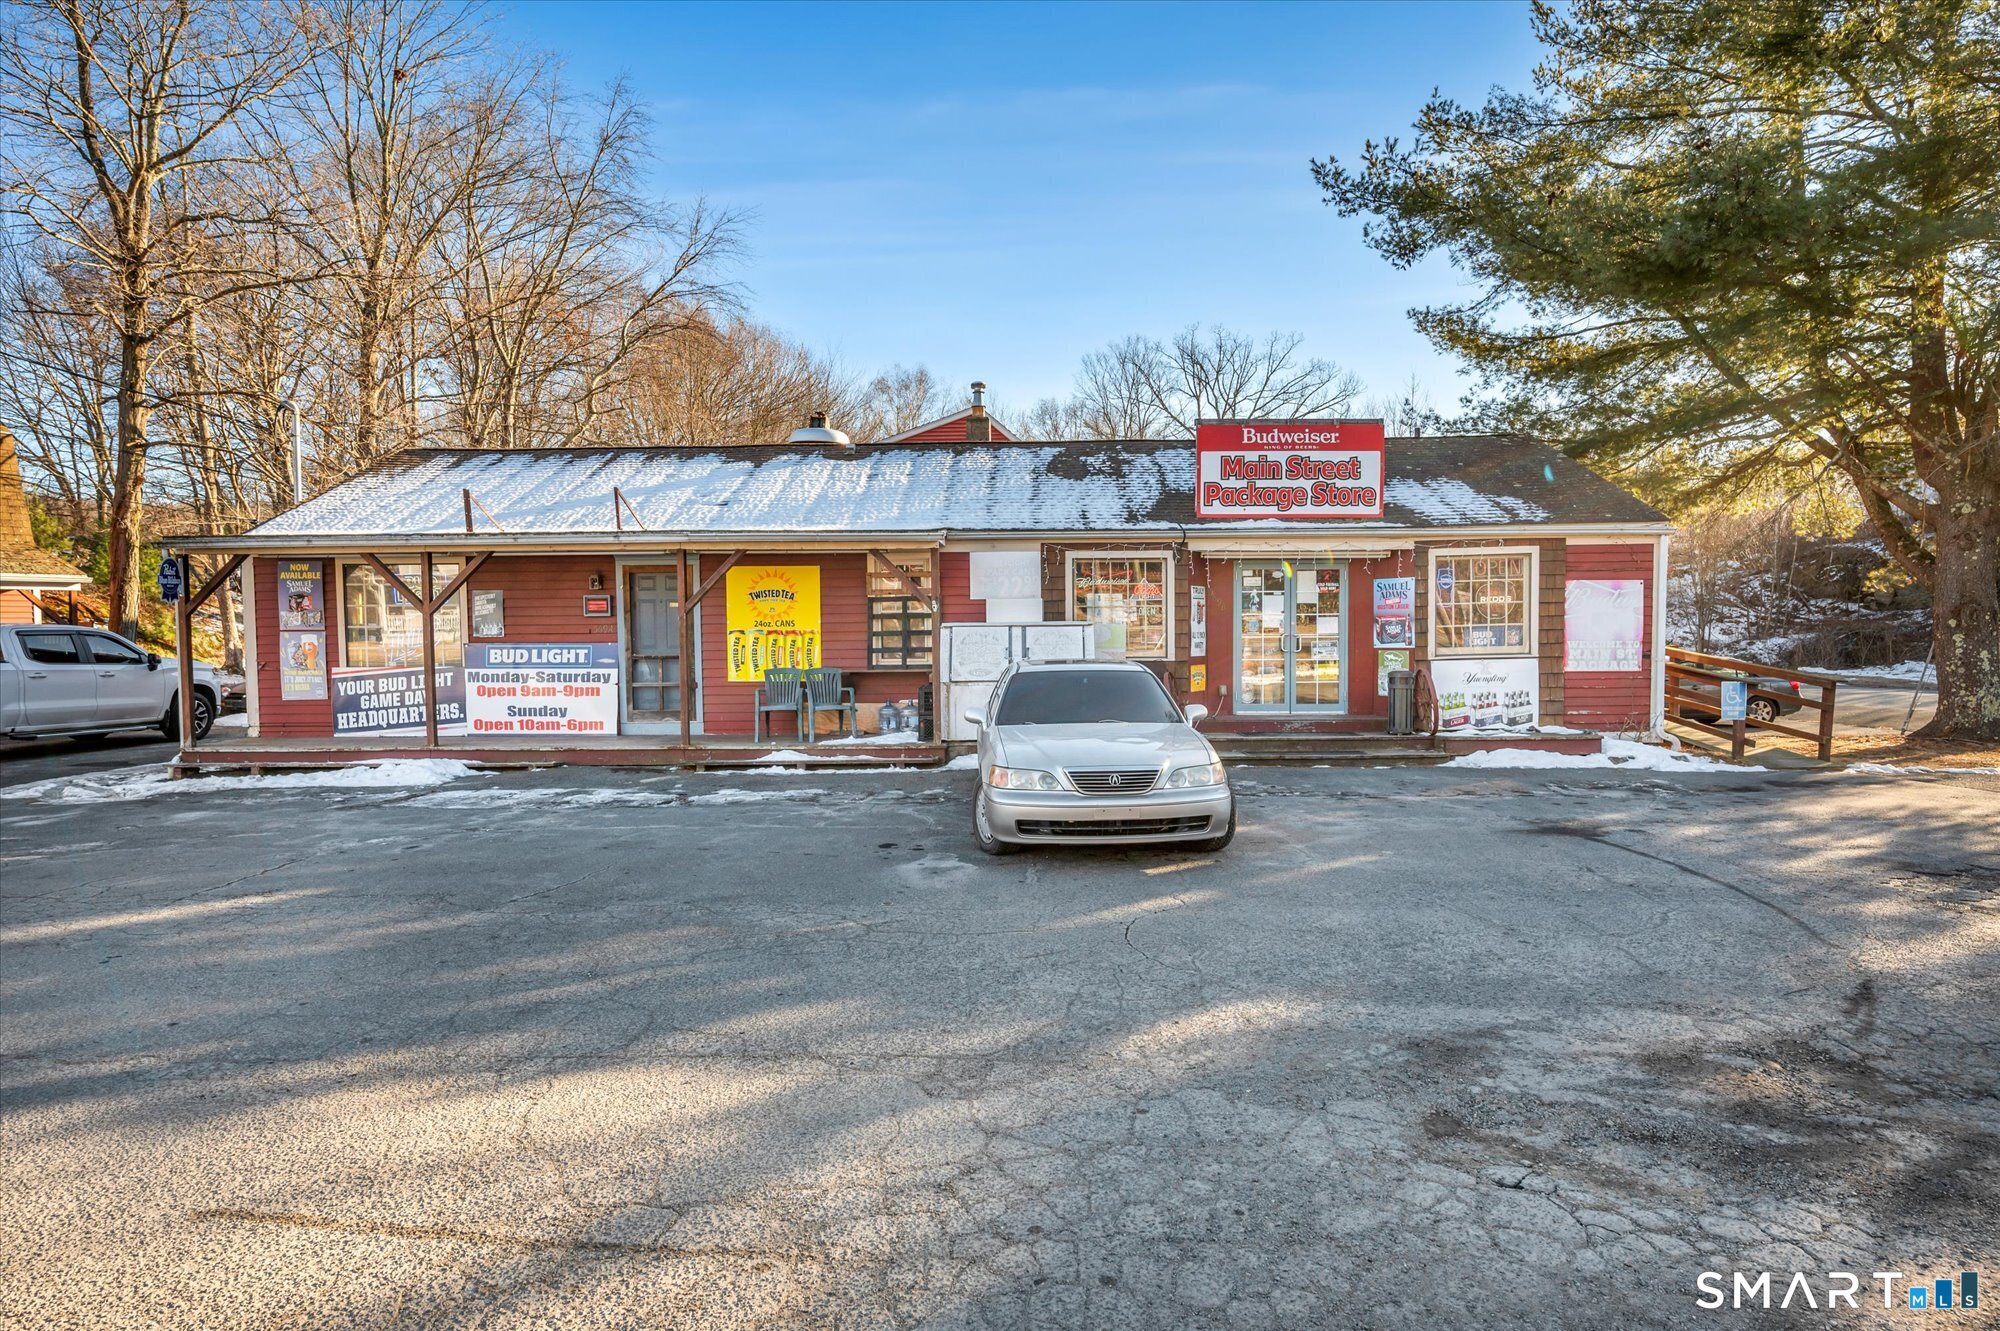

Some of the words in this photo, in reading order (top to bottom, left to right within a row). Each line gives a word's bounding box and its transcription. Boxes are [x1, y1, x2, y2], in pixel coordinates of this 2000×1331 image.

[1242, 428, 1339, 444] Budweiser
[1221, 455, 1282, 480] Main
[1286, 455, 1361, 480] Street
[1204, 481, 1308, 512] Package
[1310, 481, 1377, 506] Store
[290, 563, 309, 571] NOW
[1474, 559, 1521, 577] OPEN
[286, 580, 314, 588] SAMUEL
[289, 586, 311, 594] ADAMS
[1377, 581, 1411, 593] SAMUEL
[748, 589, 780, 601] TWISTED
[781, 590, 795, 601] TEA
[1379, 590, 1408, 601] ADAMS
[754, 620, 774, 628] 24oz.
[775, 619, 796, 628] CANS
[733, 637, 741, 648] TEA
[1625, 640, 1640, 648] TO
[489, 648, 529, 664] BUD
[531, 648, 588, 664] LIGHT
[733, 648, 742, 673] TWISTED
[751, 648, 760, 673] TWISTED
[1568, 648, 1613, 660] MAIN
[1616, 648, 1638, 660] ST.
[337, 680, 375, 697] YOUR
[378, 676, 408, 693] BUD
[411, 672, 454, 690] LIHT
[467, 671, 611, 685] Monday-Saturday
[1462, 672, 1507, 686] Yuengling
[476, 685, 517, 699] Open
[520, 685, 601, 699] 9am-9pm
[360, 691, 401, 709] GAME
[404, 690, 426, 706] DA
[507, 705, 568, 718] Sunday
[473, 719, 514, 732] Open
[517, 719, 604, 732] 10am-6pm
